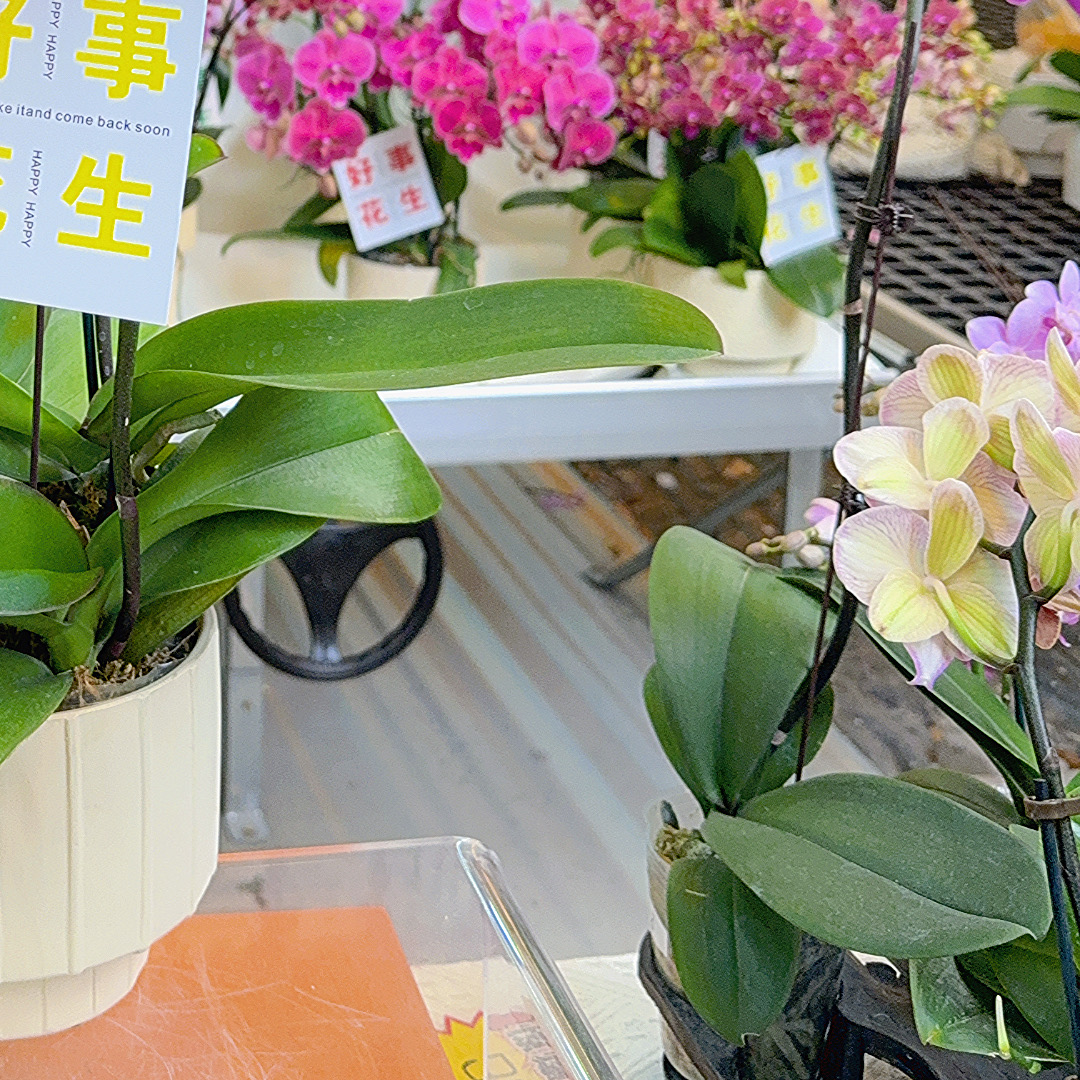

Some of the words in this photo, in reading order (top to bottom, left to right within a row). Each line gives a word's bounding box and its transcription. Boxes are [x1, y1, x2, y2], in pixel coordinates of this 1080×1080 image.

[43, 34, 58, 81] HAPPY
[55, 112, 94, 126] come
[97, 115, 132, 132] back
[135, 123, 170, 137] soon
[27, 149, 43, 196] HAPPY
[21, 201, 36, 248] HAPPY
